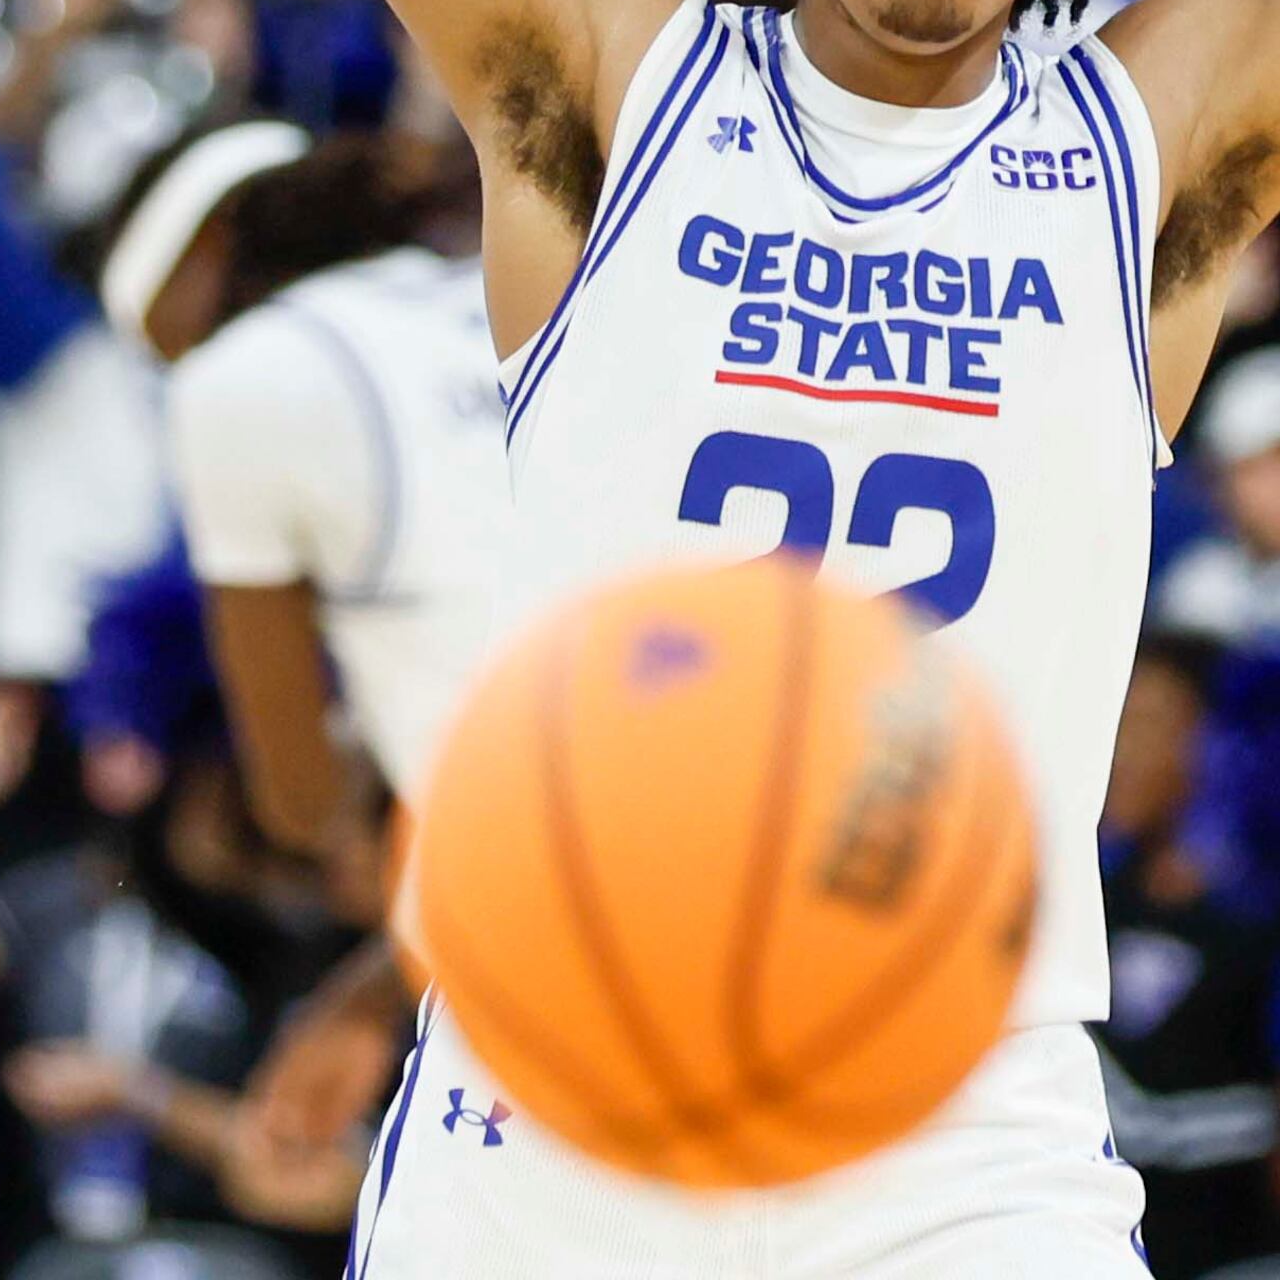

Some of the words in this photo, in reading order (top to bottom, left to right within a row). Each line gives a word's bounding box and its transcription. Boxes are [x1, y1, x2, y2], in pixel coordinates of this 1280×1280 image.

[990, 143, 1097, 191] SBC
[677, 213, 1065, 325] GEORGIA
[721, 302, 1002, 393] STATE
